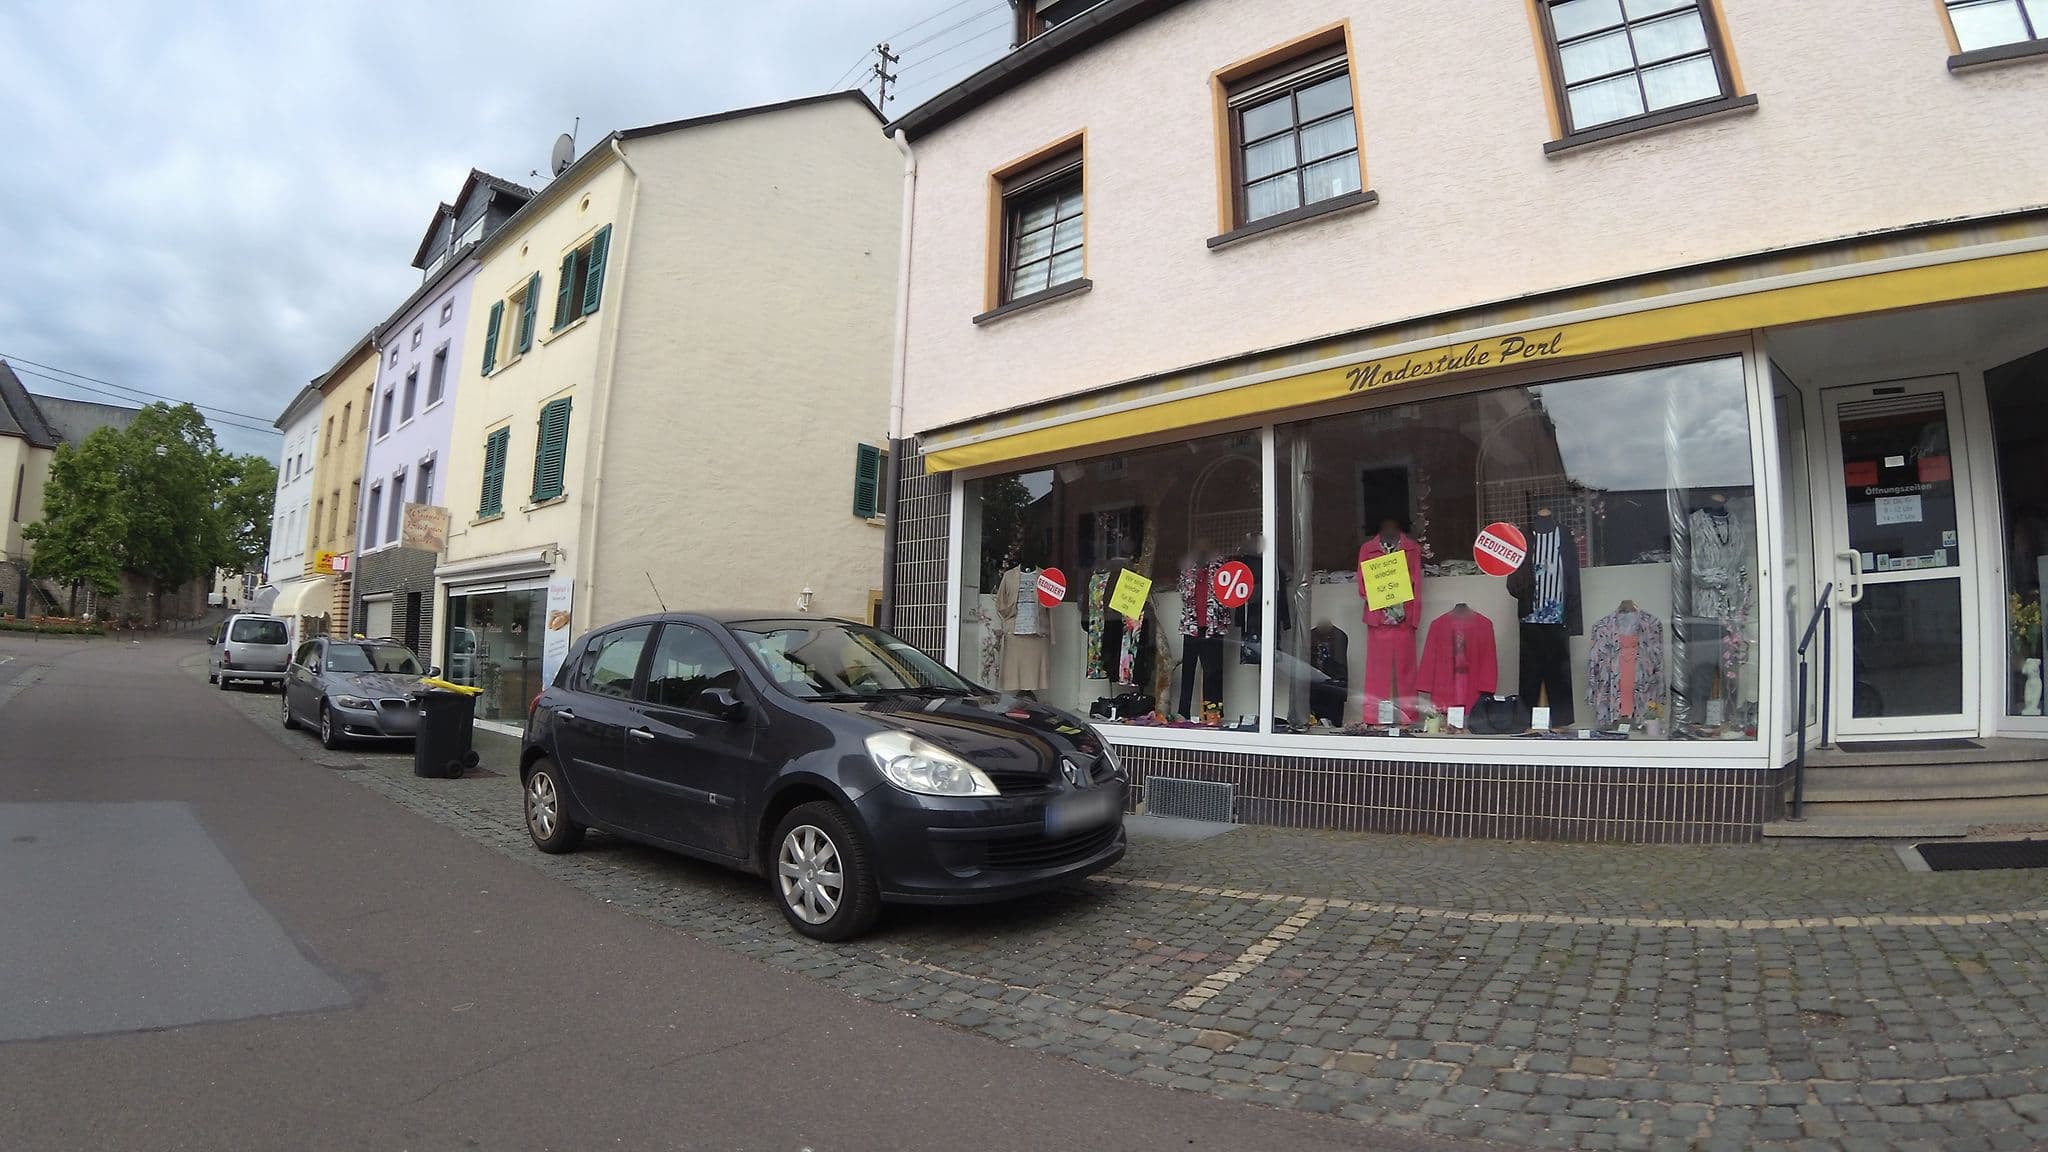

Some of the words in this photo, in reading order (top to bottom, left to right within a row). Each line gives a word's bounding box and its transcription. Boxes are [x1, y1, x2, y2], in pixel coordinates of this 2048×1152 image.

[1345, 344, 1489, 392] Modestube
[1500, 332, 1562, 363] Perl
[1865, 484, 1932, 495] Öffnungszeiten
[1478, 535, 1522, 564] REDUZIERT
[1383, 558, 1397, 566] sind
[1375, 569, 1396, 578] wieder
[1038, 577, 1065, 598] REDUZIERT
[1218, 569, 1249, 600] %
